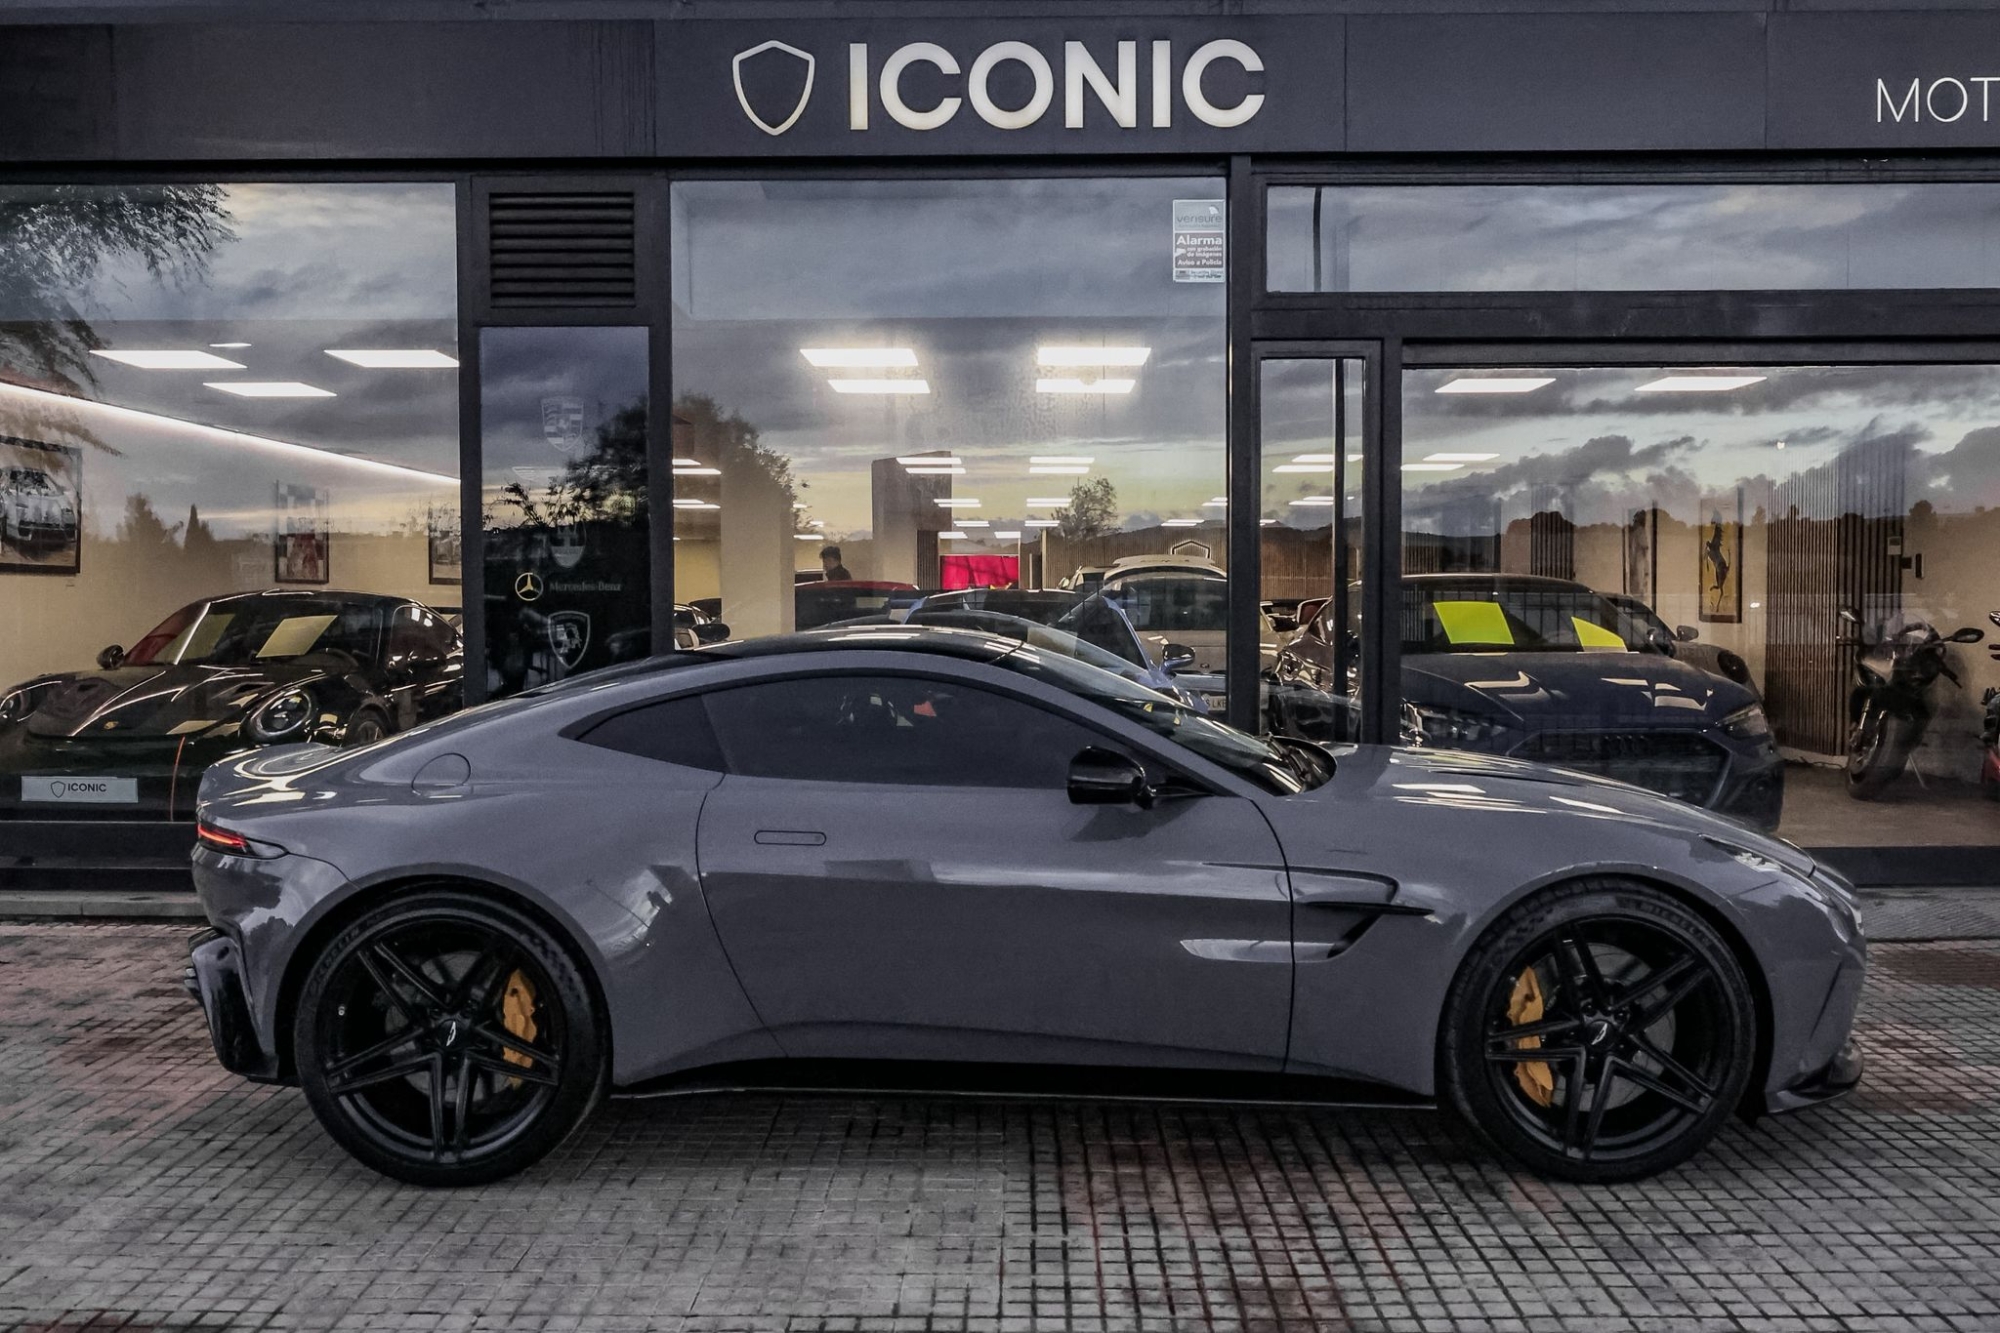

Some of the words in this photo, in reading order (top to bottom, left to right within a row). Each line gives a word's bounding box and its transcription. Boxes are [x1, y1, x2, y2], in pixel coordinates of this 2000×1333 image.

[849, 39, 1265, 130] ICONIC
[1877, 77, 2000, 123] MOT
[1176, 215, 1222, 224] verisure
[1176, 234, 1222, 245] Alarma
[67, 783, 107, 793] ICONIC
